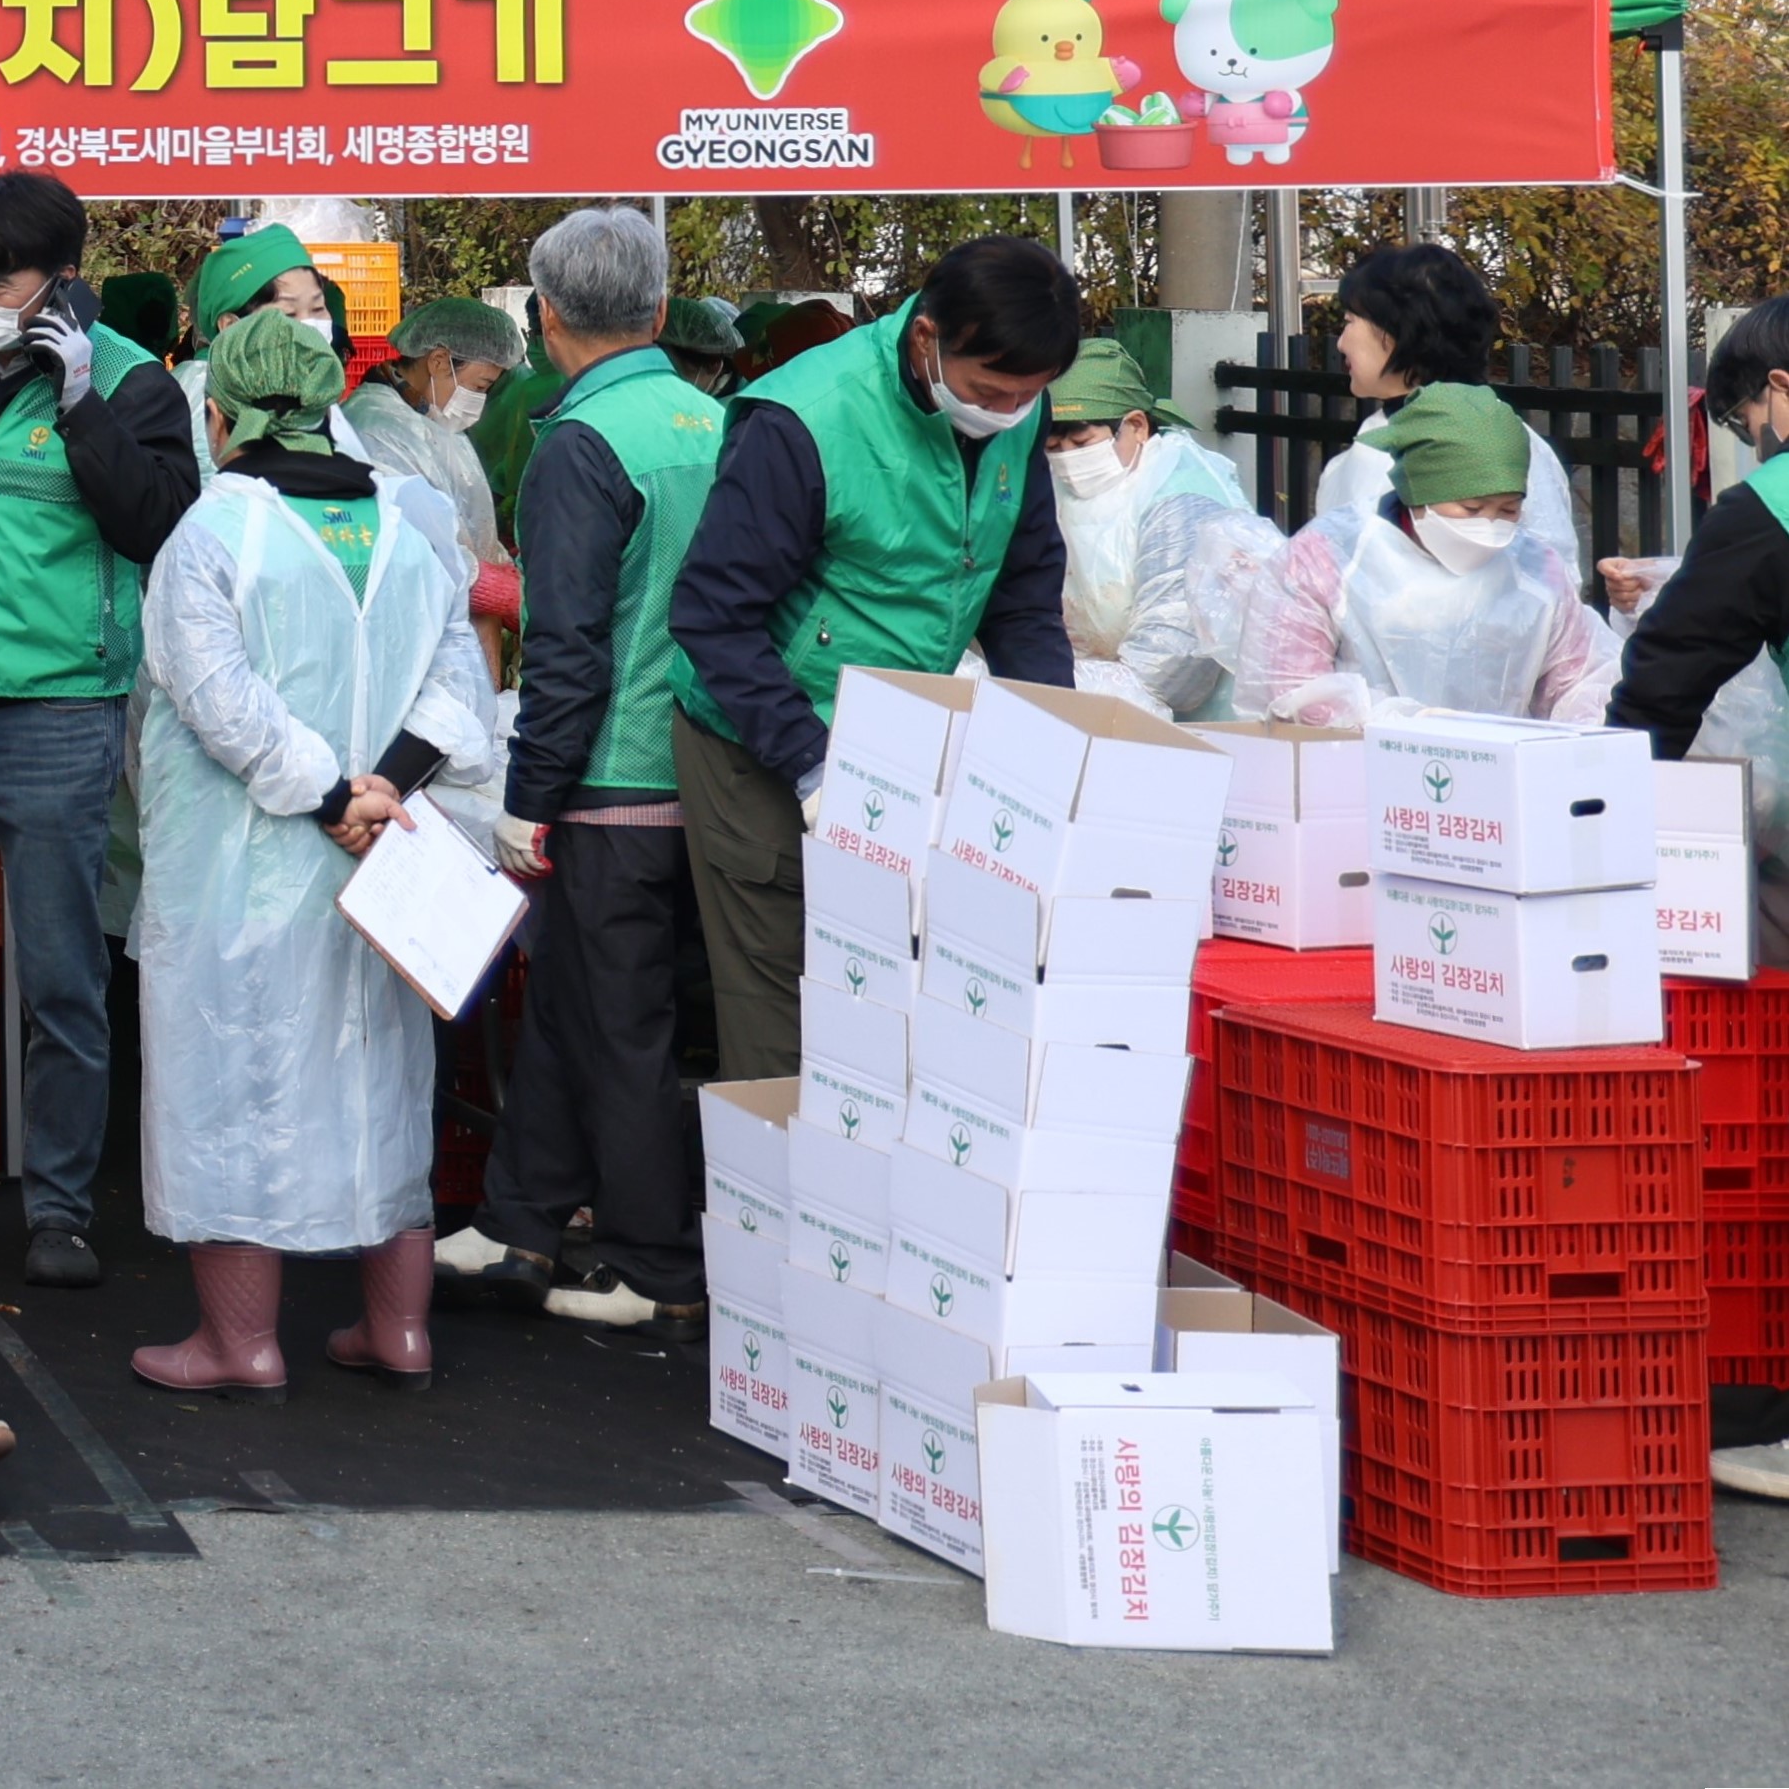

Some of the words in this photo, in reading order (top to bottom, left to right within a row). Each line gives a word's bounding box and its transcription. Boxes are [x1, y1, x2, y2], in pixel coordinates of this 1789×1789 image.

[685, 114, 724, 131] MY
[726, 113, 844, 131] UNIVERSE
[16, 126, 333, 166] 경상북도새마을부녀회,
[342, 124, 528, 165] 세명종합병원
[661, 138, 870, 167] GYEONGSAN
[1384, 806, 1430, 835] 사랑의
[1437, 813, 1503, 846] 김장김치
[826, 822, 861, 855] 사랑의
[865, 839, 912, 877] 김장김치
[1222, 877, 1281, 907] 김장김치
[1656, 908, 1722, 934] 장김치
[1390, 955, 1436, 985] 사랑의
[1441, 964, 1504, 998] 김장김치
[719, 1365, 748, 1397] 사랑의
[799, 1422, 833, 1456] 사랑의
[891, 1462, 926, 1500] 사랑의
[1114, 1438, 1143, 1512] 사랑의
[1118, 1523, 1149, 1621] 김장김치
